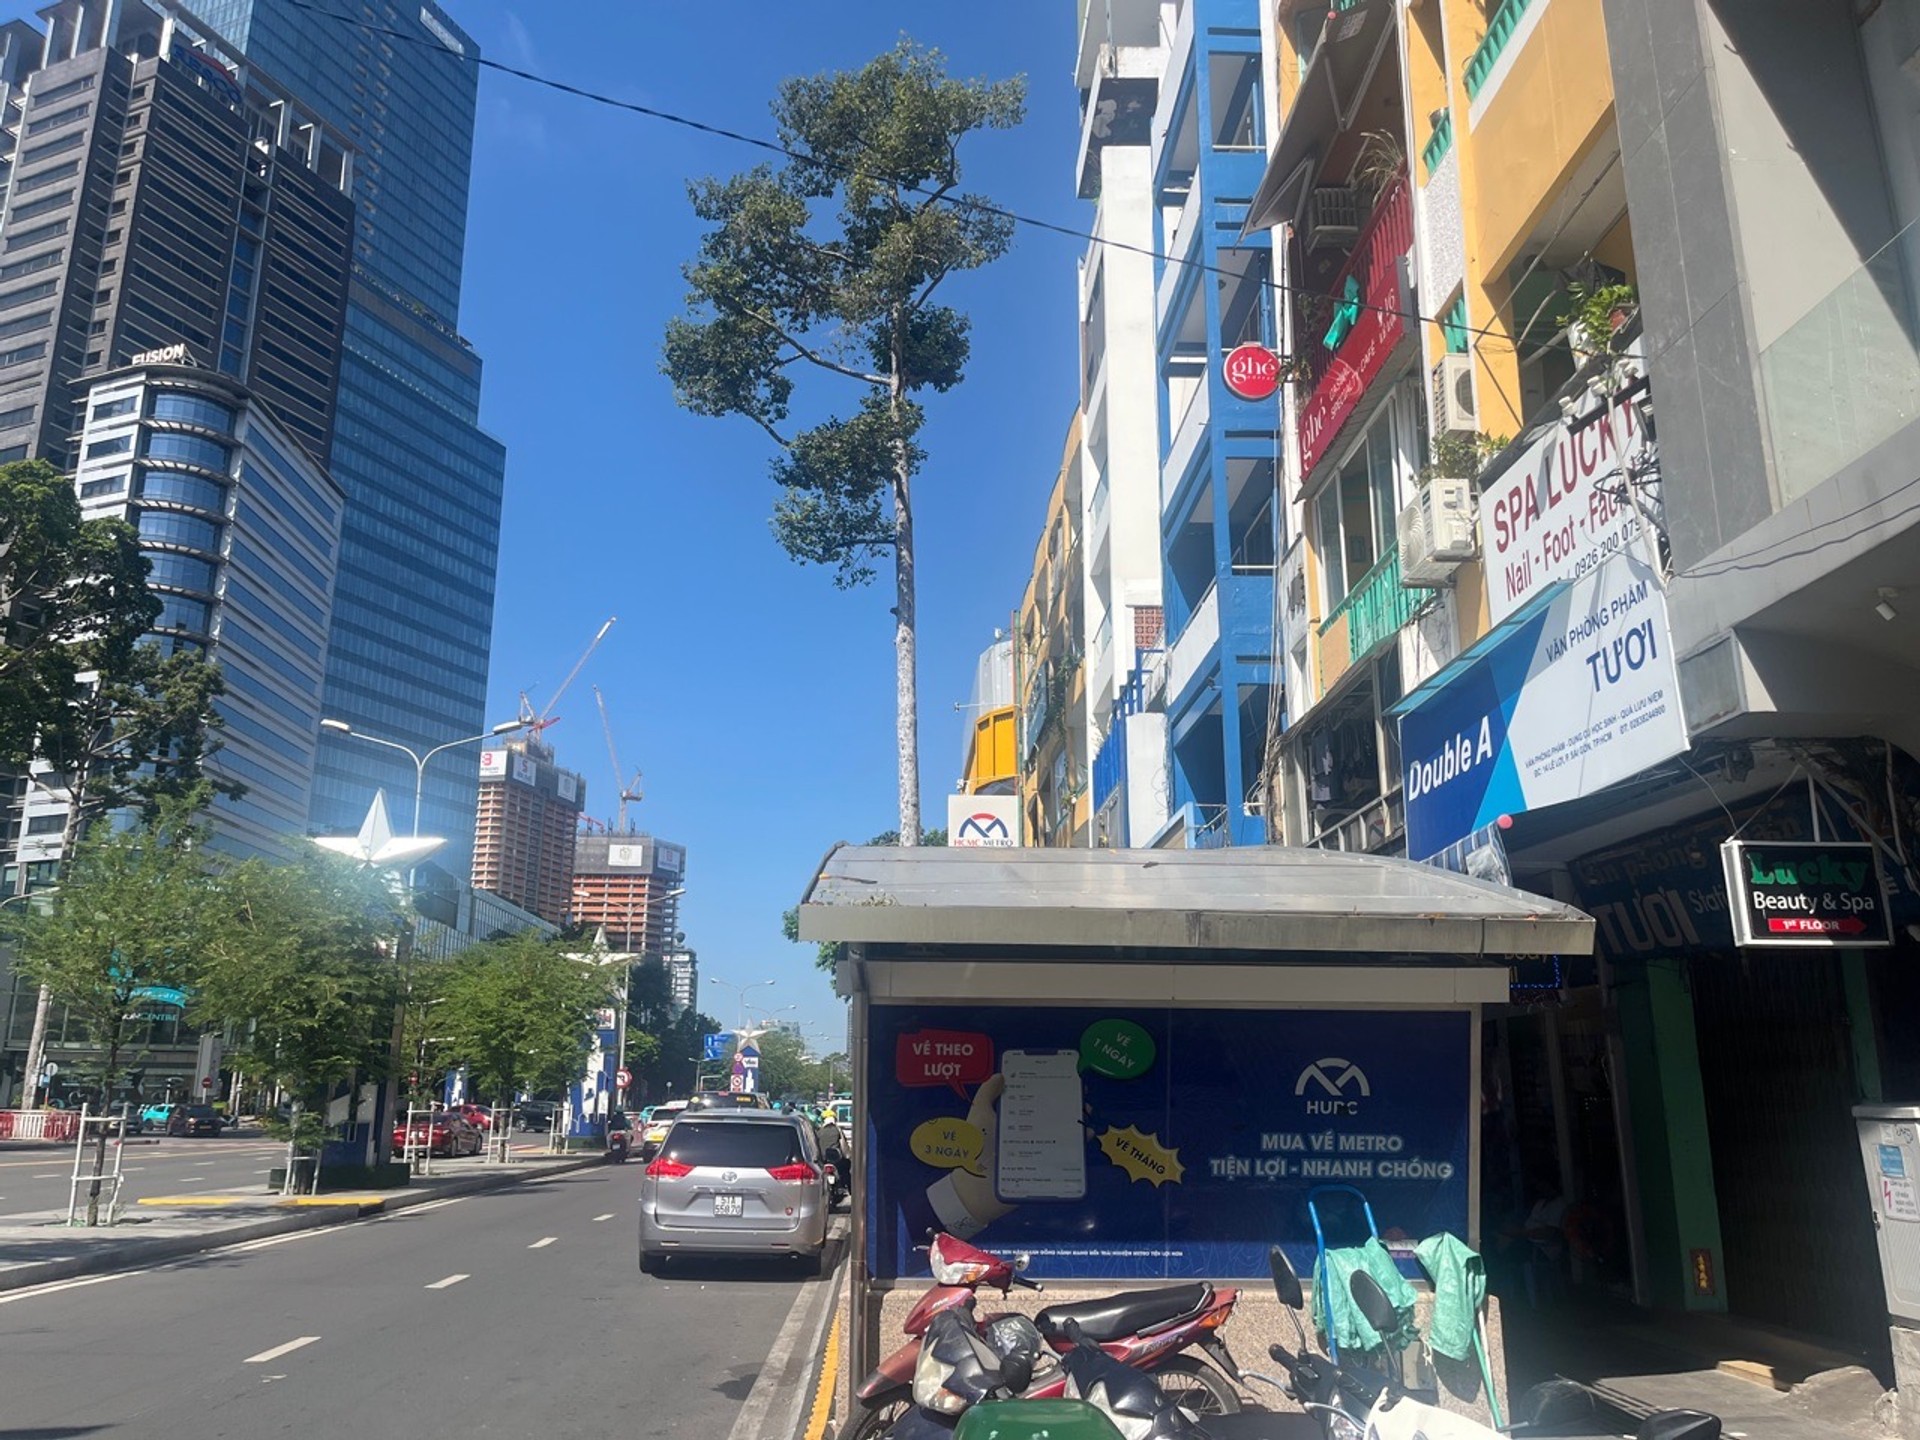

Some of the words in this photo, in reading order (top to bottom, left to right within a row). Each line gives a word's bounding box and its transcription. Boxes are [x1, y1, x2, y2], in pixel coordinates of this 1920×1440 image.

[132, 343, 185, 365] FUSION
[1494, 473, 1541, 554] SPA
[1505, 550, 1532, 602] Nail
[1543, 514, 1576, 572] Foot
[1574, 552, 1599, 578] 0926
[1600, 532, 1619, 556] 200
[1545, 637, 1568, 663] VĂN
[1568, 609, 1609, 646] PHÒNG
[1586, 618, 1658, 693] TƯƠI
[1408, 732, 1472, 802] Double
[1475, 715, 1493, 765] A
[983, 838, 1014, 848] METRO
[1747, 851, 1869, 890] Lucky
[1754, 890, 1818, 915] Beauty
[1822, 892, 1837, 910] &
[1842, 892, 1875, 914] Spa
[1800, 920, 1840, 931] FLOOR
[912, 1040, 931, 1056] VÉ
[934, 1043, 974, 1056] THEO
[1101, 1044, 1136, 1069] NGÀY
[924, 1062, 962, 1080] LƯỢT
[1262, 1133, 1304, 1151] MUA
[1310, 1130, 1333, 1151] VÉ
[1339, 1135, 1403, 1151] METRO
[1129, 1147, 1166, 1176] THÁNG
[1210, 1155, 1249, 1181] TIỆN
[1255, 1157, 1286, 1181] LỢI
[1302, 1161, 1372, 1177] NHANH
[1378, 1158, 1454, 1178] CHÓNG
